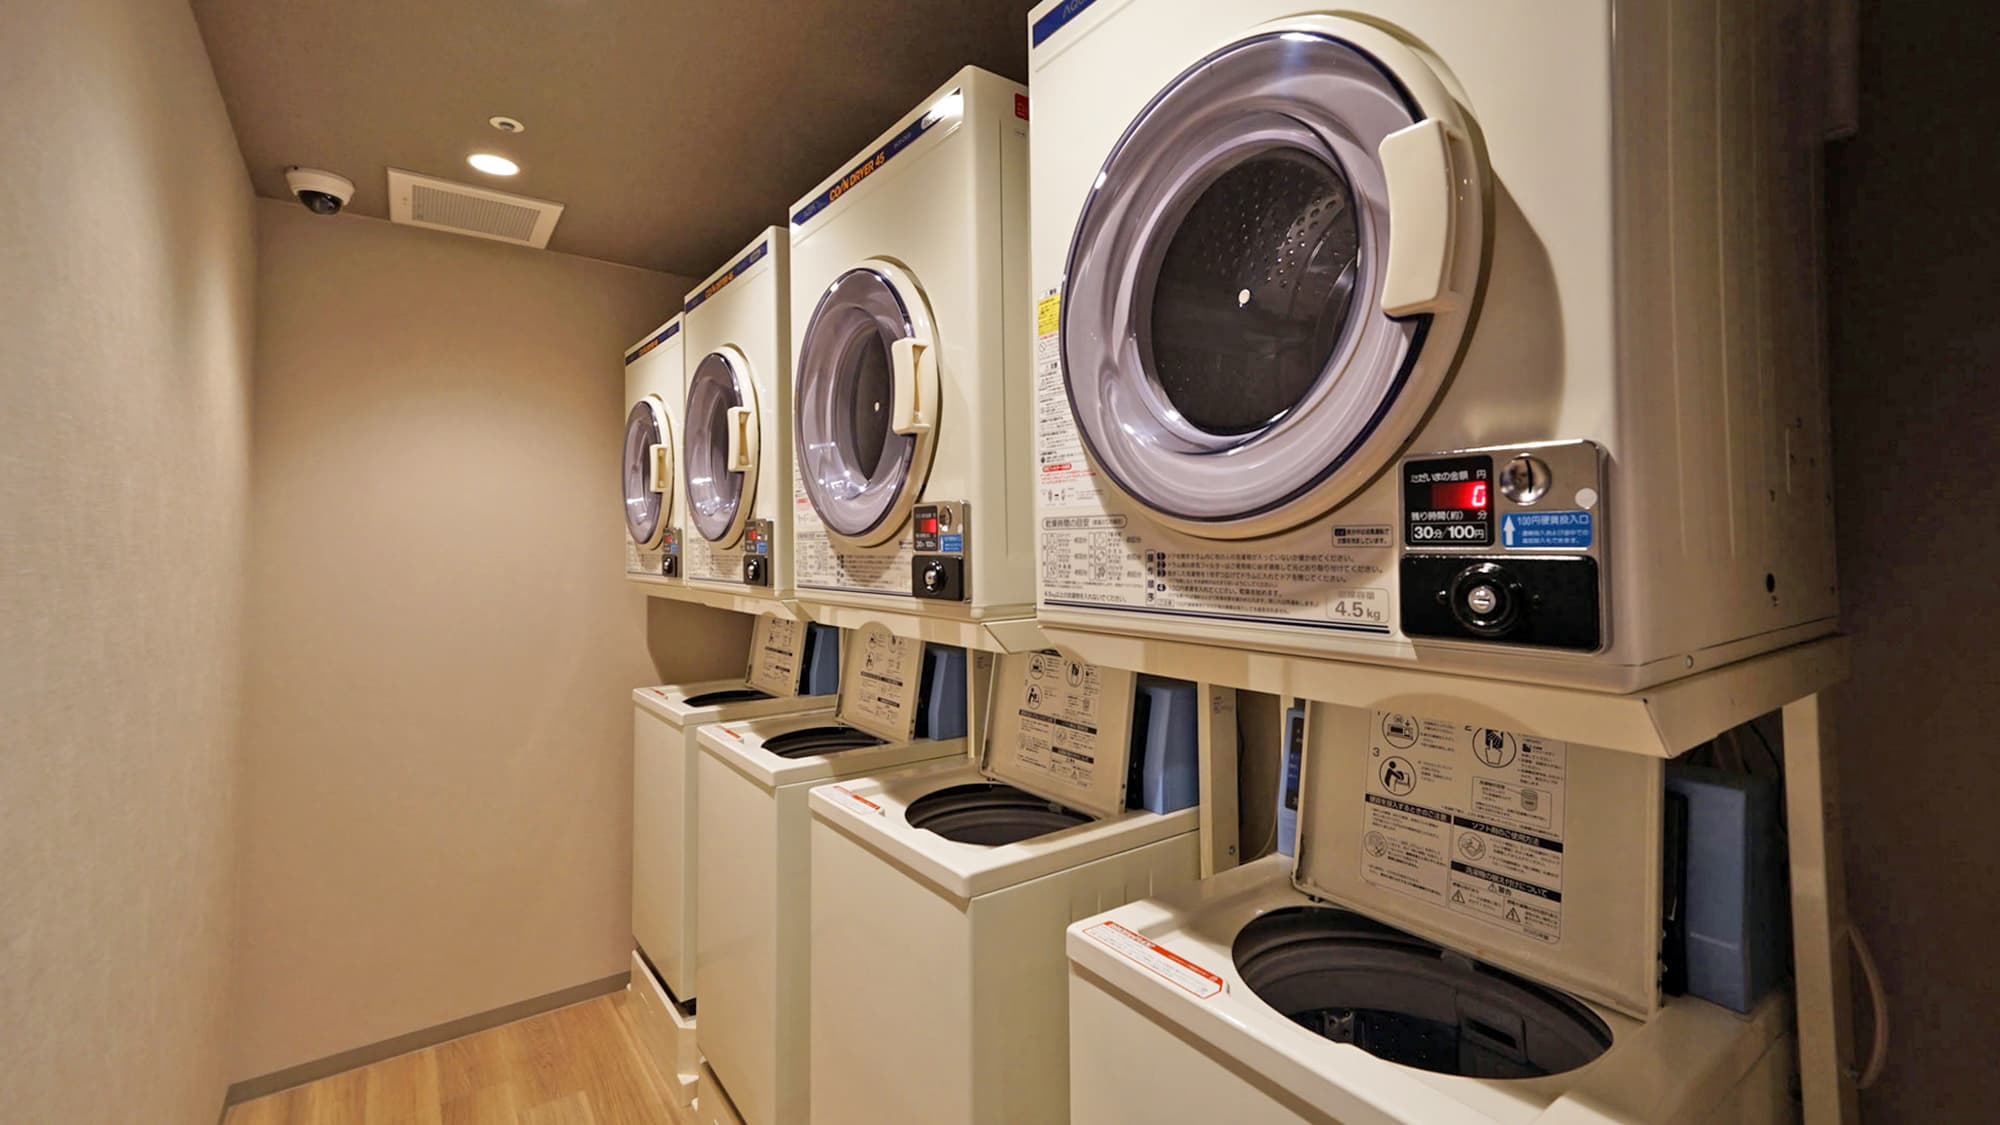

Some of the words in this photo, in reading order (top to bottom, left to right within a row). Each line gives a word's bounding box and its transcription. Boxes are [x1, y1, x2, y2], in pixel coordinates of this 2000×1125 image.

[829, 177, 849, 201] COIN
[850, 160, 874, 187] DRYER
[875, 151, 885, 166] 45
[1476, 469, 1487, 479] 円
[1477, 510, 1488, 520] 分
[1372, 747, 1380, 757] 3
